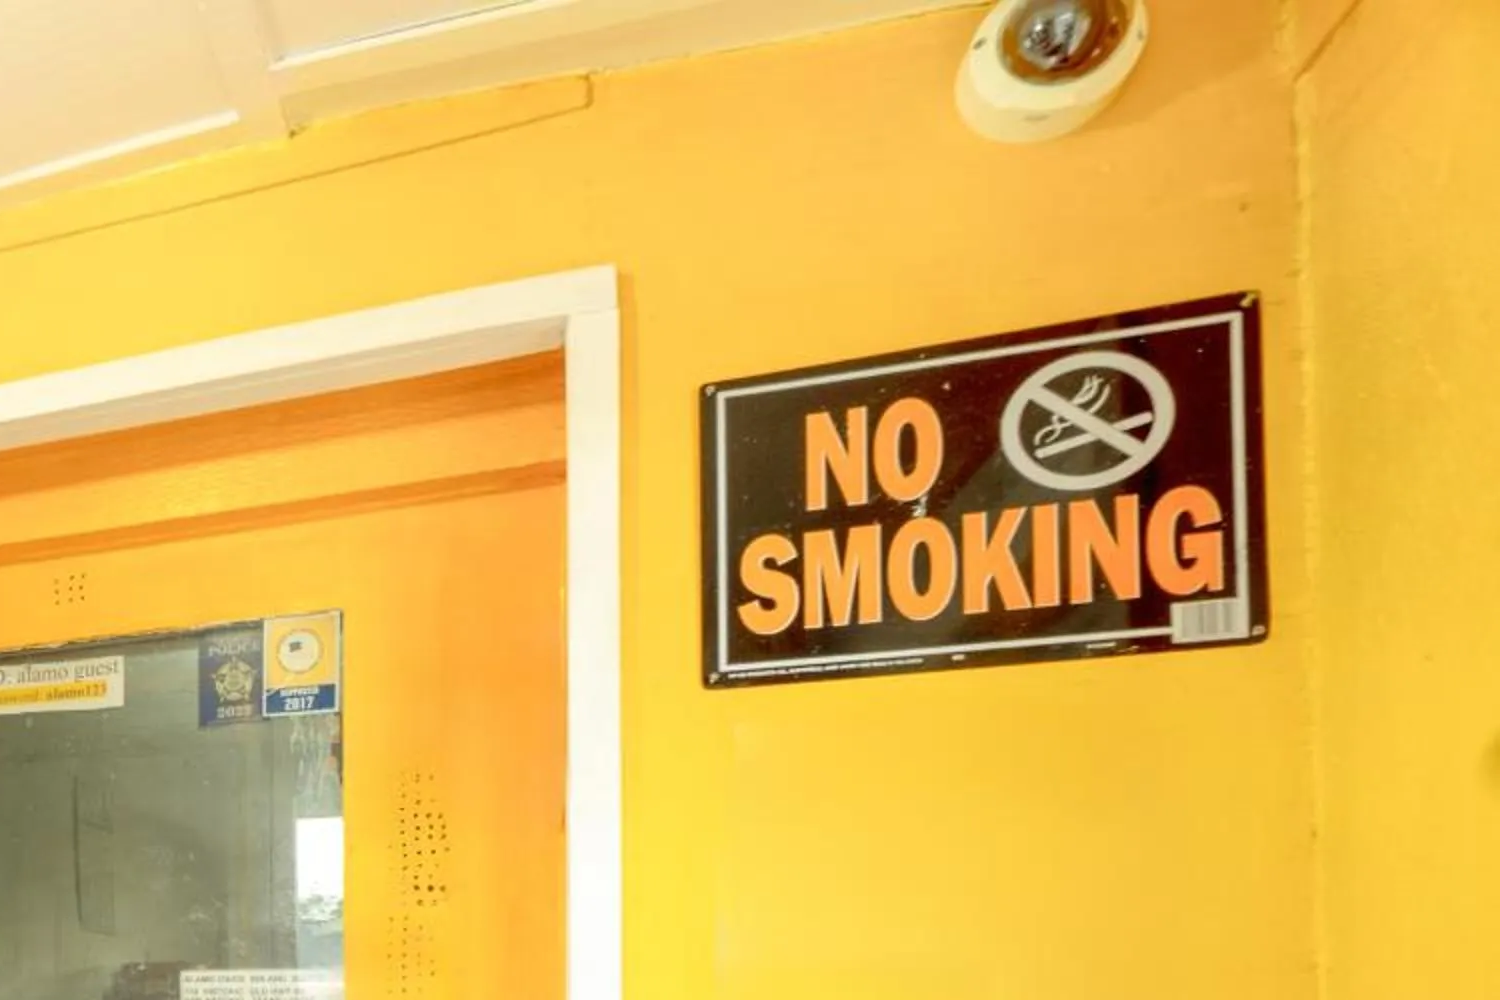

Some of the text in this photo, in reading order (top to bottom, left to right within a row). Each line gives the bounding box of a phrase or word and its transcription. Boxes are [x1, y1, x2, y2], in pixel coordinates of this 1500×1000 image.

[805, 397, 945, 511] NO
[737, 484, 1225, 636] SMOKING
[17, 665, 69, 684] alamo
[74, 659, 119, 683] guest
[284, 695, 316, 711] 2017
